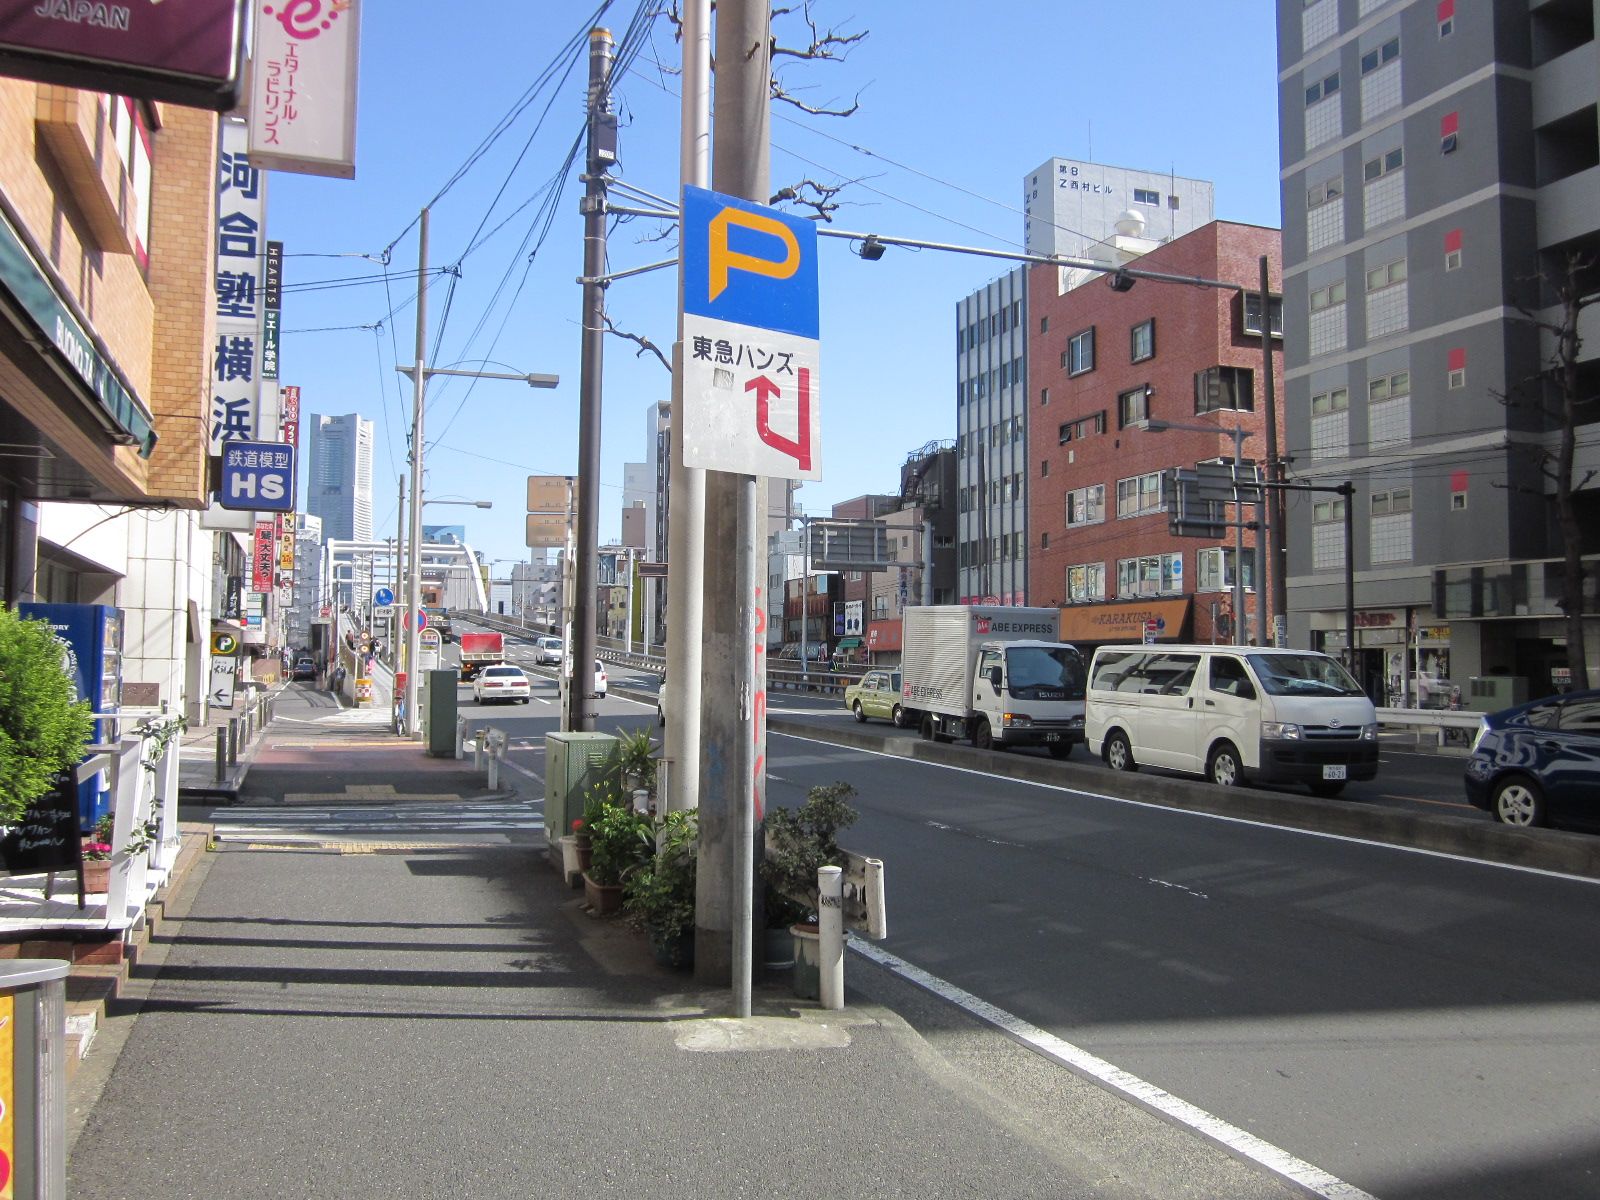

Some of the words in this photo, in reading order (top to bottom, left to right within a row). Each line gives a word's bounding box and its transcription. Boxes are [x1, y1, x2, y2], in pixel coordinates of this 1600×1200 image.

[34, 0, 130, 31] JAPAN
[264, 61, 281, 145] ラビリンス
[709, 206, 800, 303] P
[267, 247, 278, 303] HEARTS
[264, 320, 276, 371] エール学院
[692, 335, 794, 376] 東急ハンズ
[228, 450, 289, 469] 鉄道模型
[231, 472, 285, 500] HS
[991, 623, 1010, 632] ABE
[1012, 624, 1053, 634] EXPRESS
[1099, 612, 1152, 625] KARAKUSA
